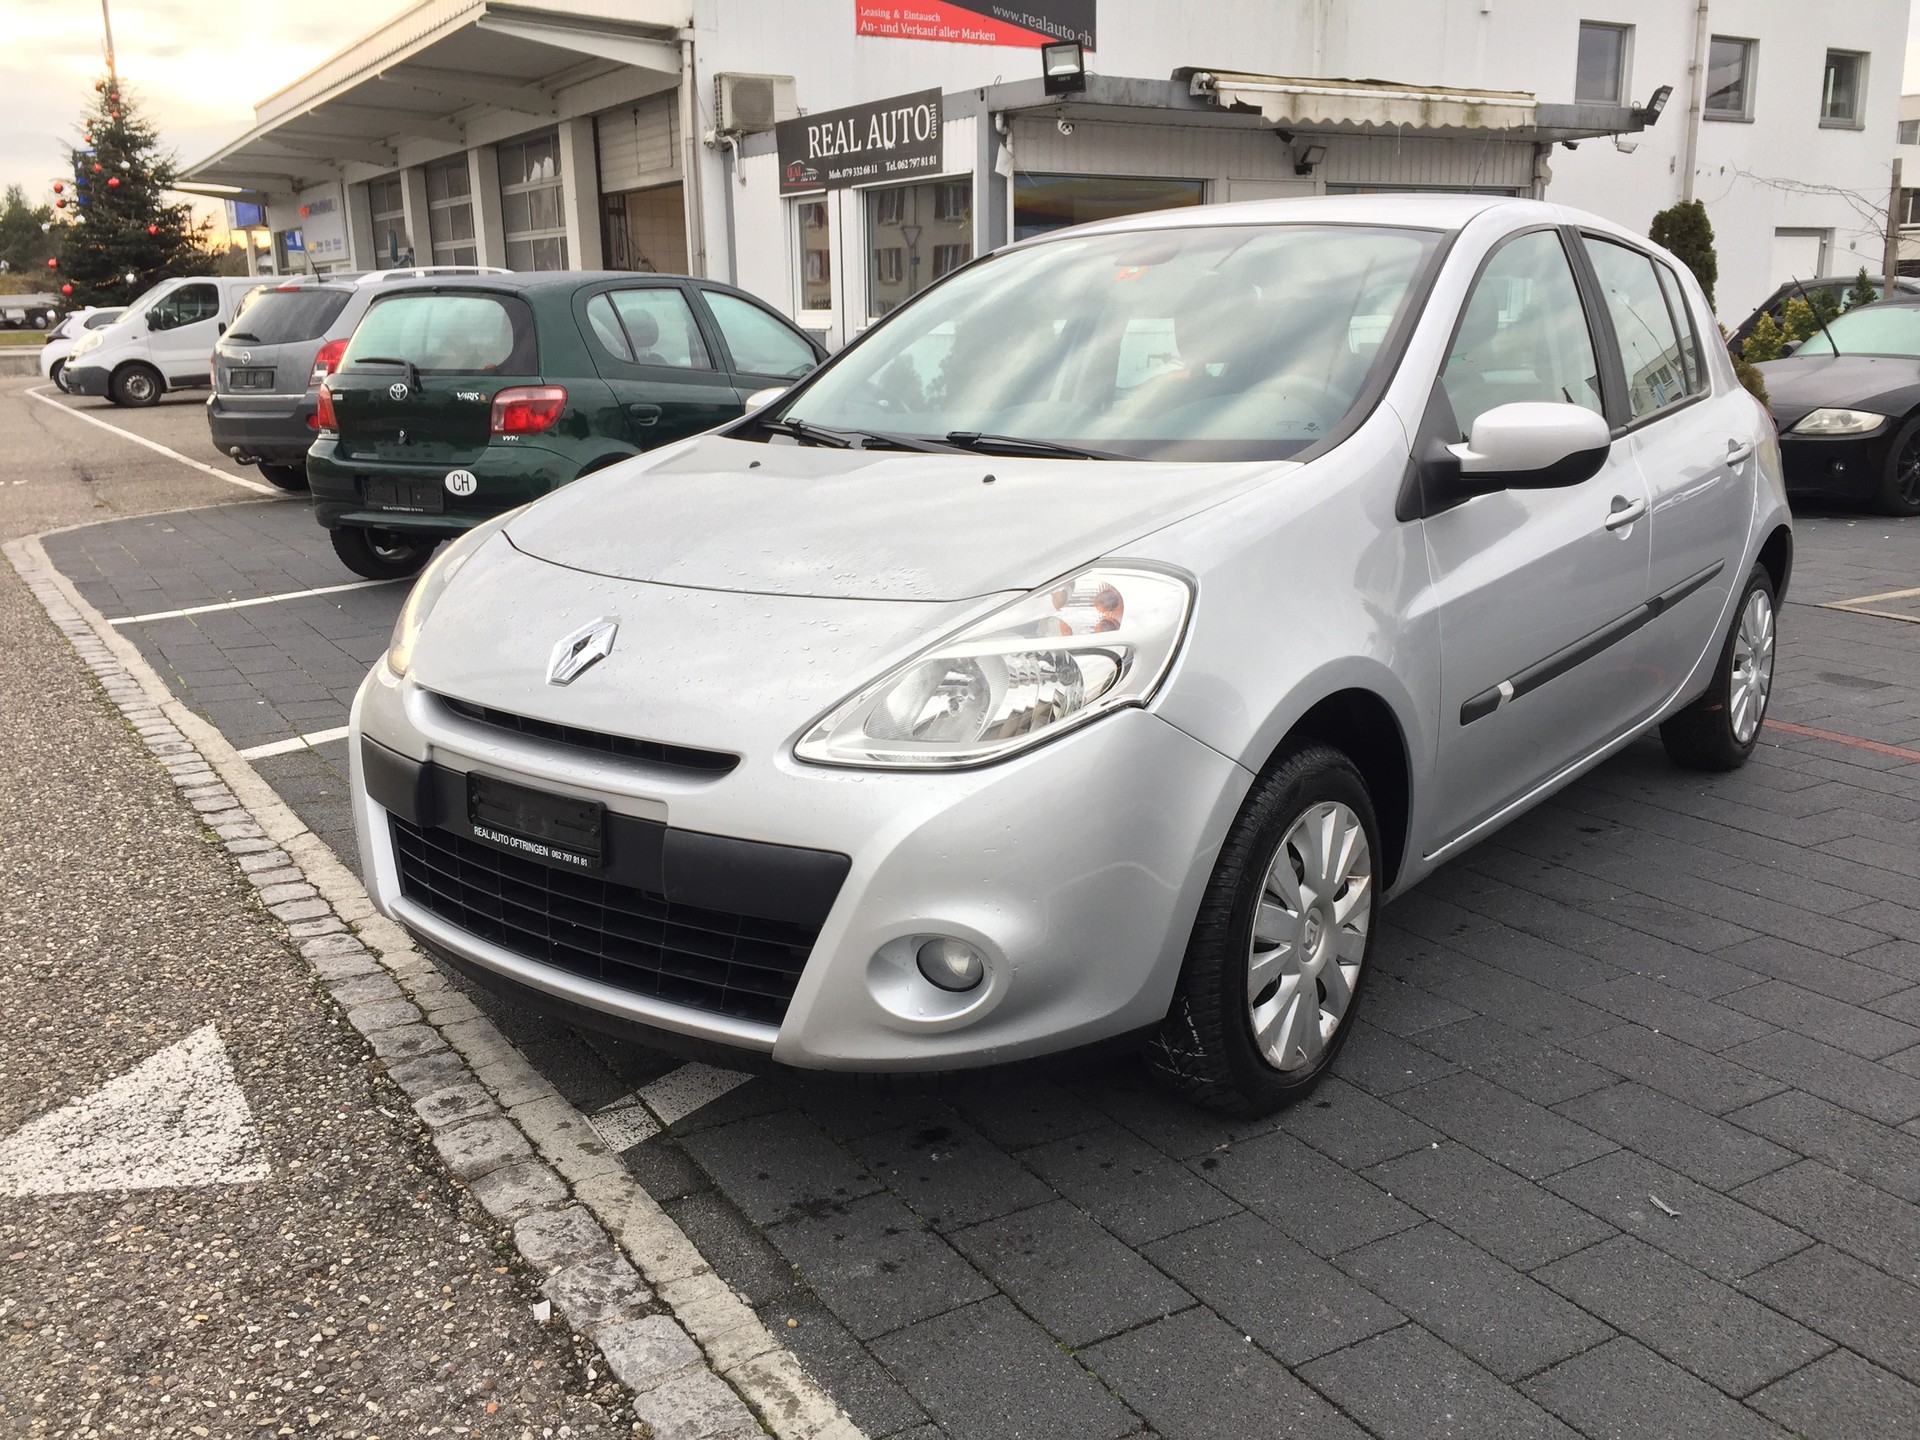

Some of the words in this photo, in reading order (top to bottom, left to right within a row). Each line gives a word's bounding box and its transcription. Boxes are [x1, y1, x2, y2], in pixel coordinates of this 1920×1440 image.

[860, 6, 891, 19] Leasing
[893, 9, 900, 19] &
[903, 10, 941, 22] Eintausch
[860, 20, 878, 32] An-
[880, 22, 899, 33] und
[901, 23, 938, 36] Verkauf
[938, 26, 959, 38] aller
[961, 28, 996, 41] Marken
[808, 118, 862, 159] REAL
[866, 104, 931, 150] AUTO
[930, 103, 938, 140] GmbH
[828, 169, 842, 180] Mob.
[842, 167, 853, 178] 079
[853, 166, 862, 177] 332
[862, 165, 871, 176] 68
[871, 164, 878, 175] 11
[885, 160, 897, 172] Tel.
[897, 158, 908, 171] 062
[908, 156, 920, 169] 797
[920, 156, 929, 167] 81
[929, 155, 937, 166] 81
[456, 392, 480, 401] YARIS
[452, 473, 470, 492] CH
[473, 825, 491, 840] REAL
[490, 831, 509, 845] AUTO
[509, 837, 549, 857] OFTRINGEN
[551, 849, 562, 860] 062
[562, 852, 573, 863] 797
[572, 855, 580, 865] 81
[580, 857, 588, 867] 81
